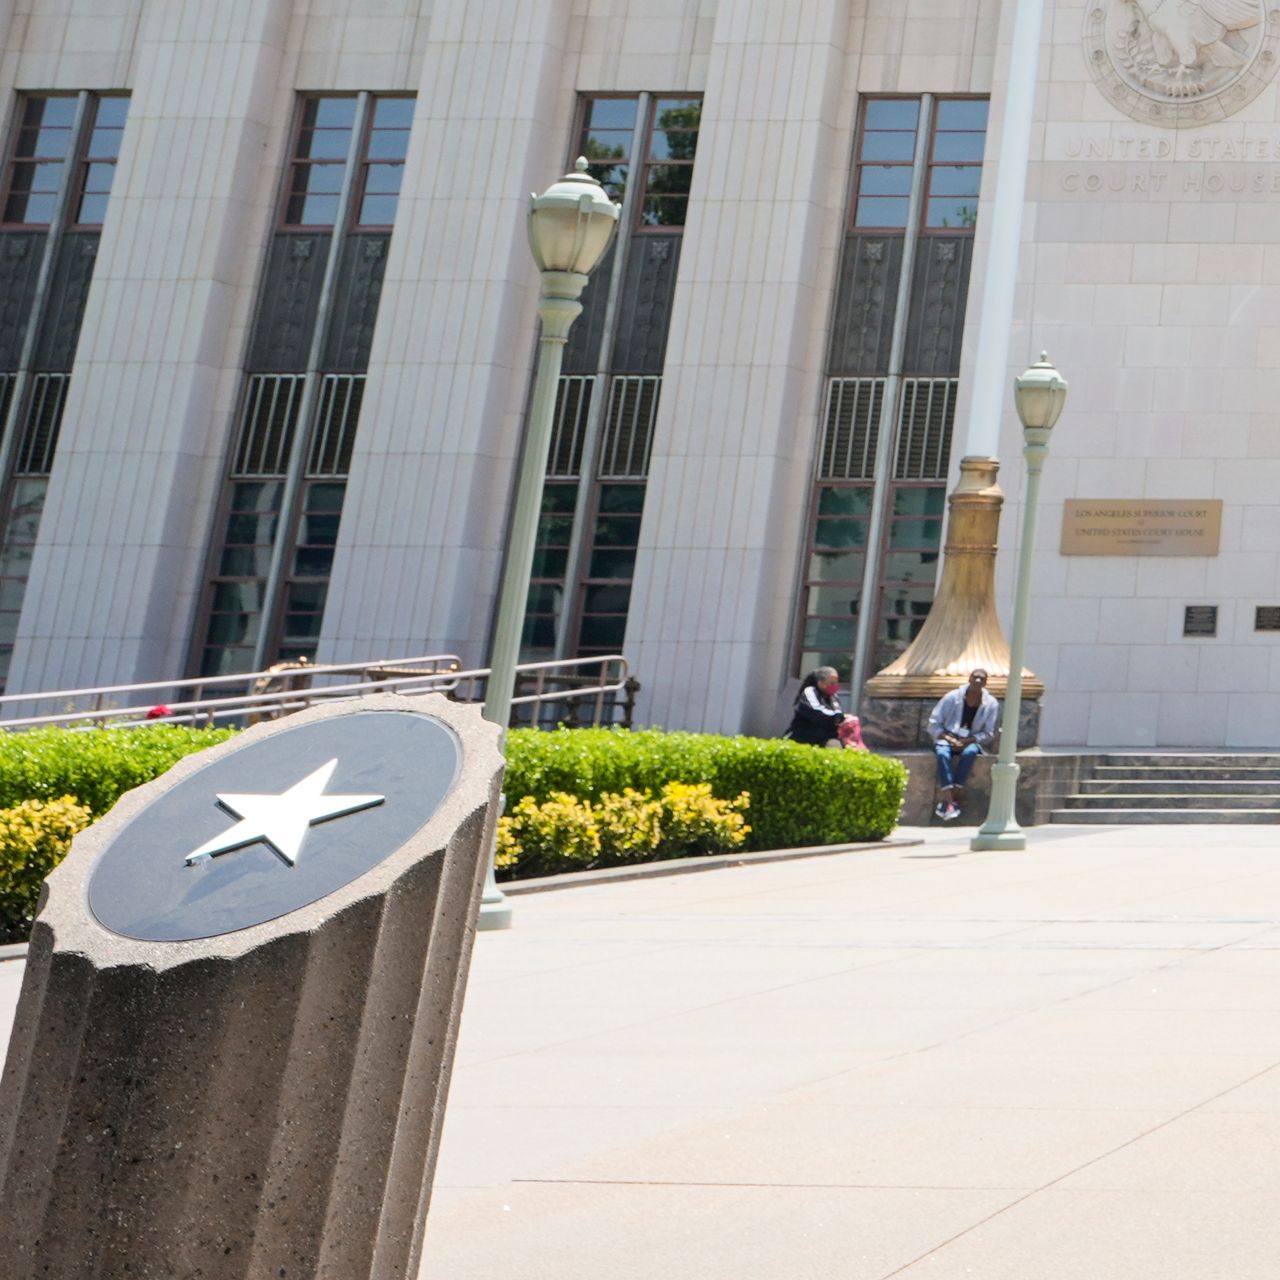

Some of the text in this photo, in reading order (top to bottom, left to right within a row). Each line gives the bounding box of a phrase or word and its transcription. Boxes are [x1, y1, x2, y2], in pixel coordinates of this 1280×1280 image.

[1064, 136, 1171, 158] UNITED
[1062, 171, 1168, 193] COURT
[1094, 509, 1132, 518] ANGELES
[1178, 509, 1207, 518] COURT
[1075, 527, 1204, 537] UNITED STATES COURT HOUSE
